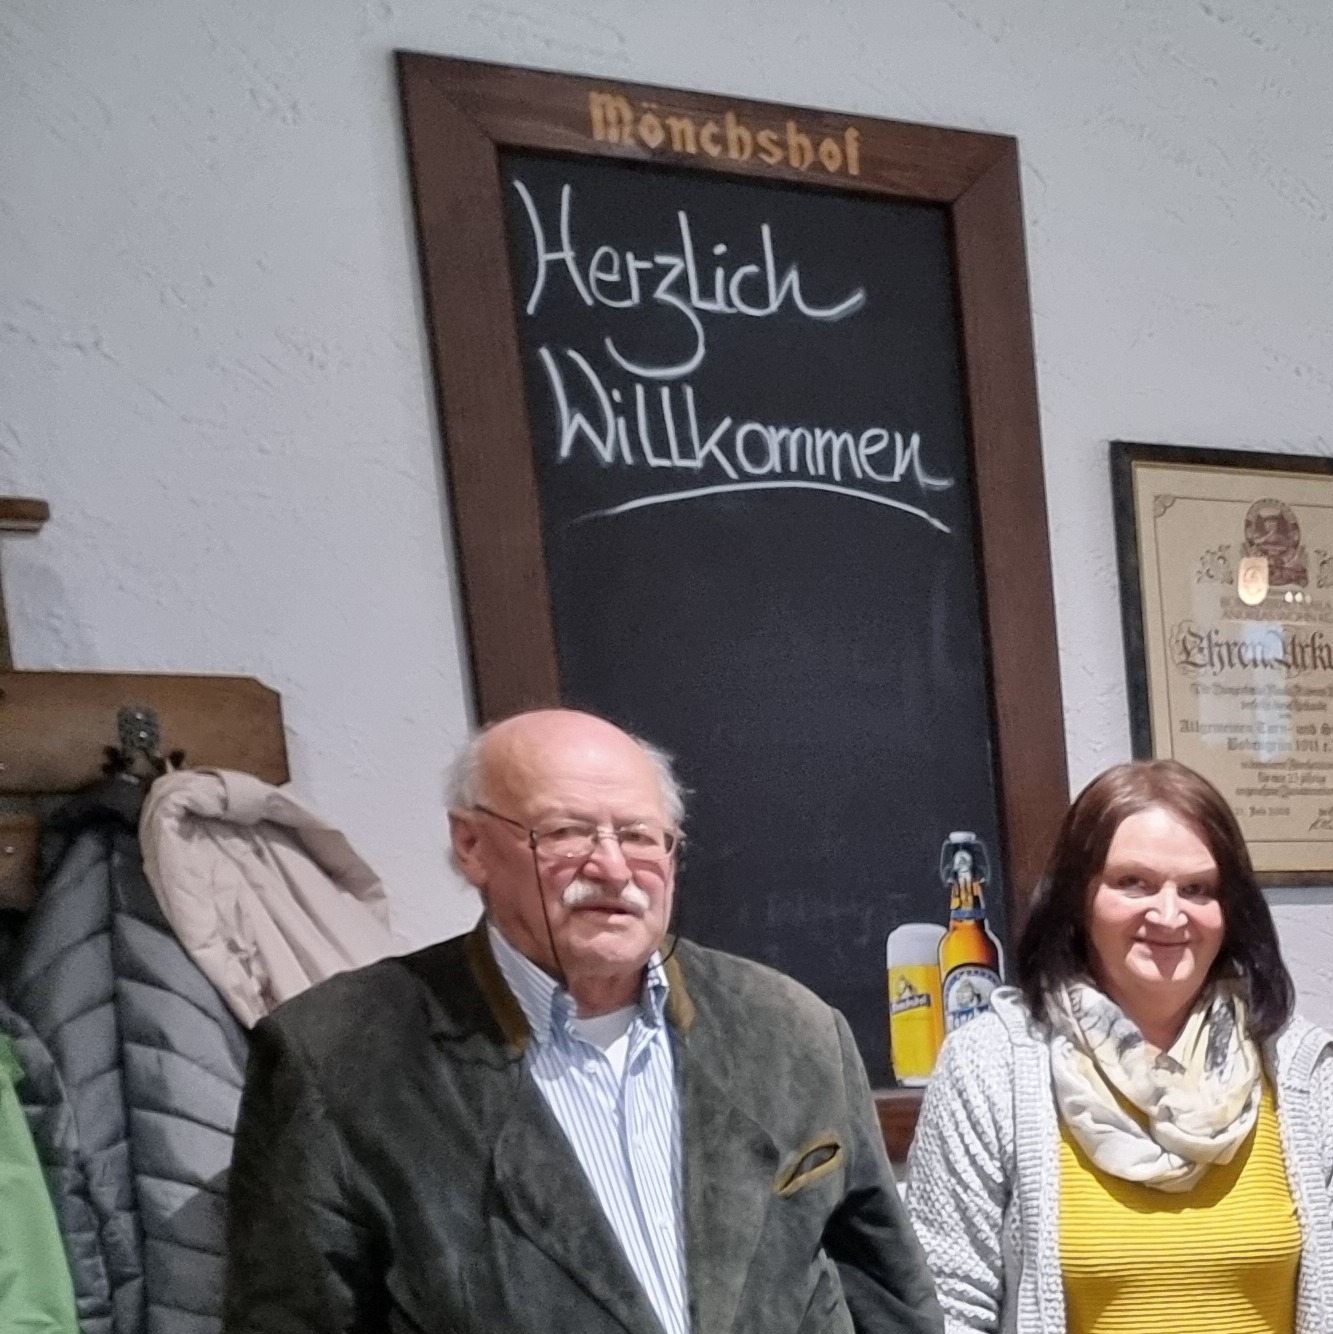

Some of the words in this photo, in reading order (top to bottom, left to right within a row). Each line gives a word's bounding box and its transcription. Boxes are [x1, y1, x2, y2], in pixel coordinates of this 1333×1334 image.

[588, 90, 862, 176] Mönchshof
[513, 178, 866, 378] Herzlich
[537, 346, 955, 489] Willkommen
